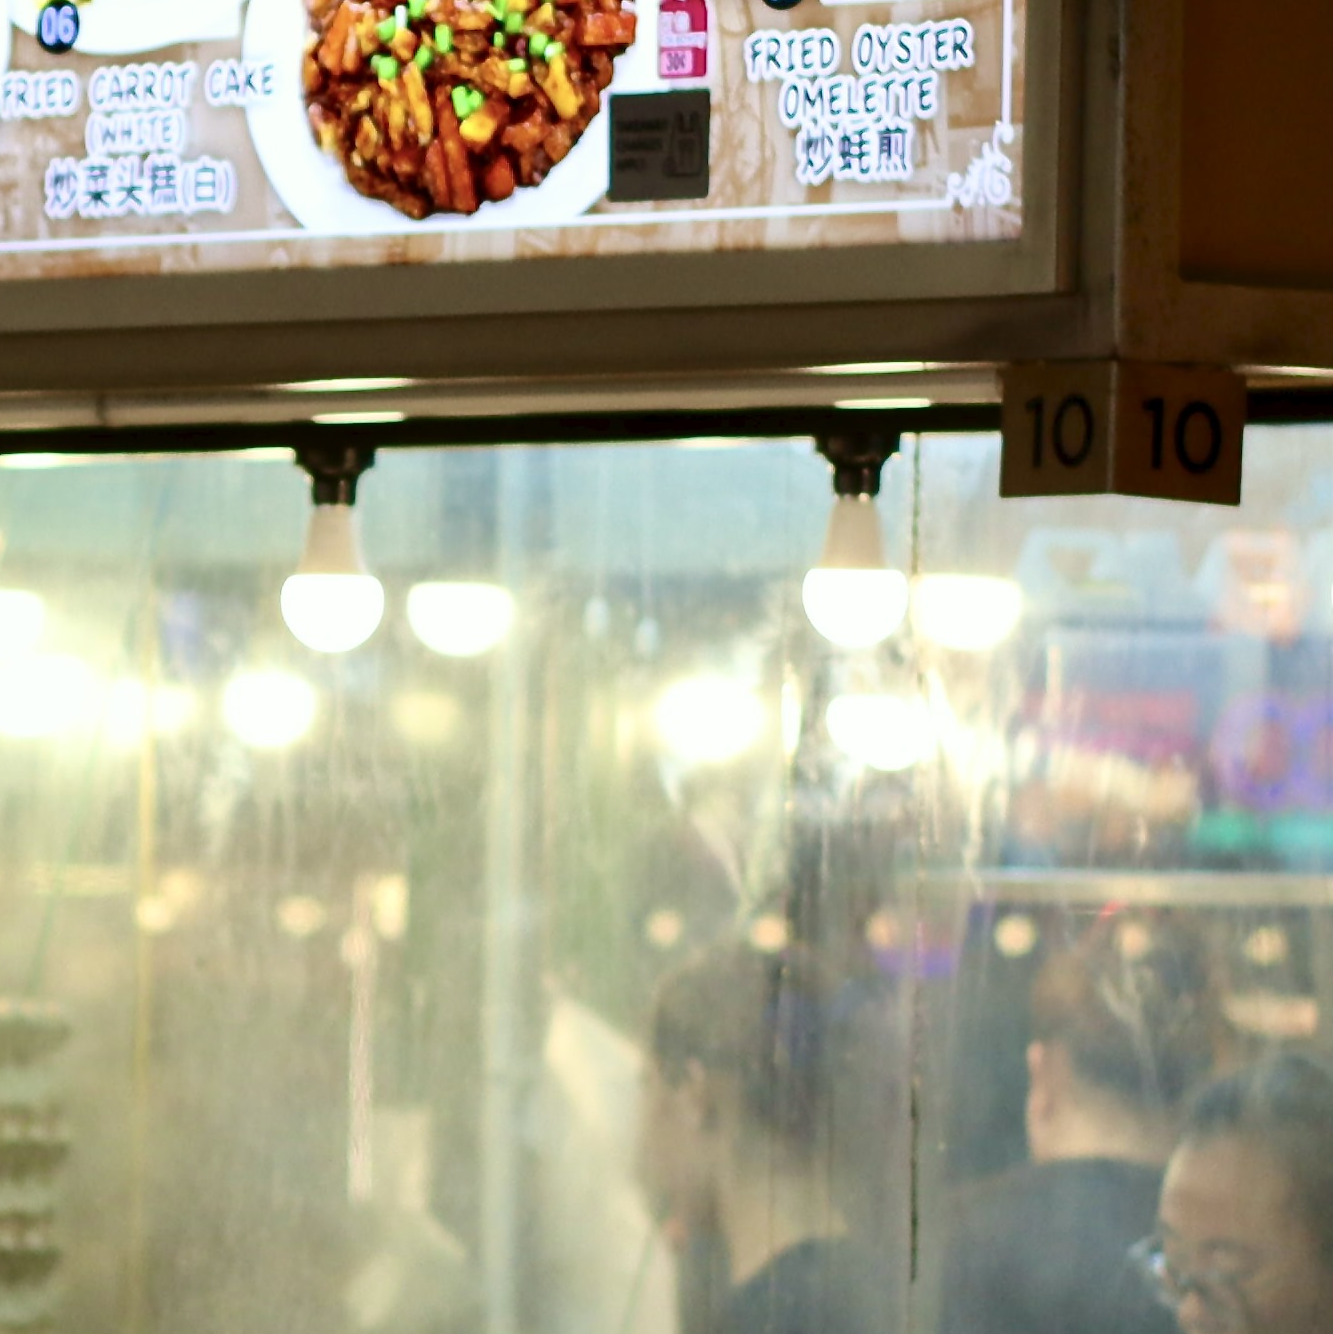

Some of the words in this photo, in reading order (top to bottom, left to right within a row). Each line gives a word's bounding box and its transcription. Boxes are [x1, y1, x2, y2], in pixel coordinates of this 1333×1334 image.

[39, 4, 76, 47] 06
[749, 35, 838, 76] FRIED
[855, 23, 971, 69] OYSTER
[0, 75, 77, 113] FRIED
[90, 66, 193, 108] CARROT
[205, 61, 276, 100] CAKE
[782, 76, 936, 122] OMELETTE
[85, 113, 186, 149] (WHITE)
[1024, 392, 1095, 472] 10
[1141, 396, 1223, 475] 10
